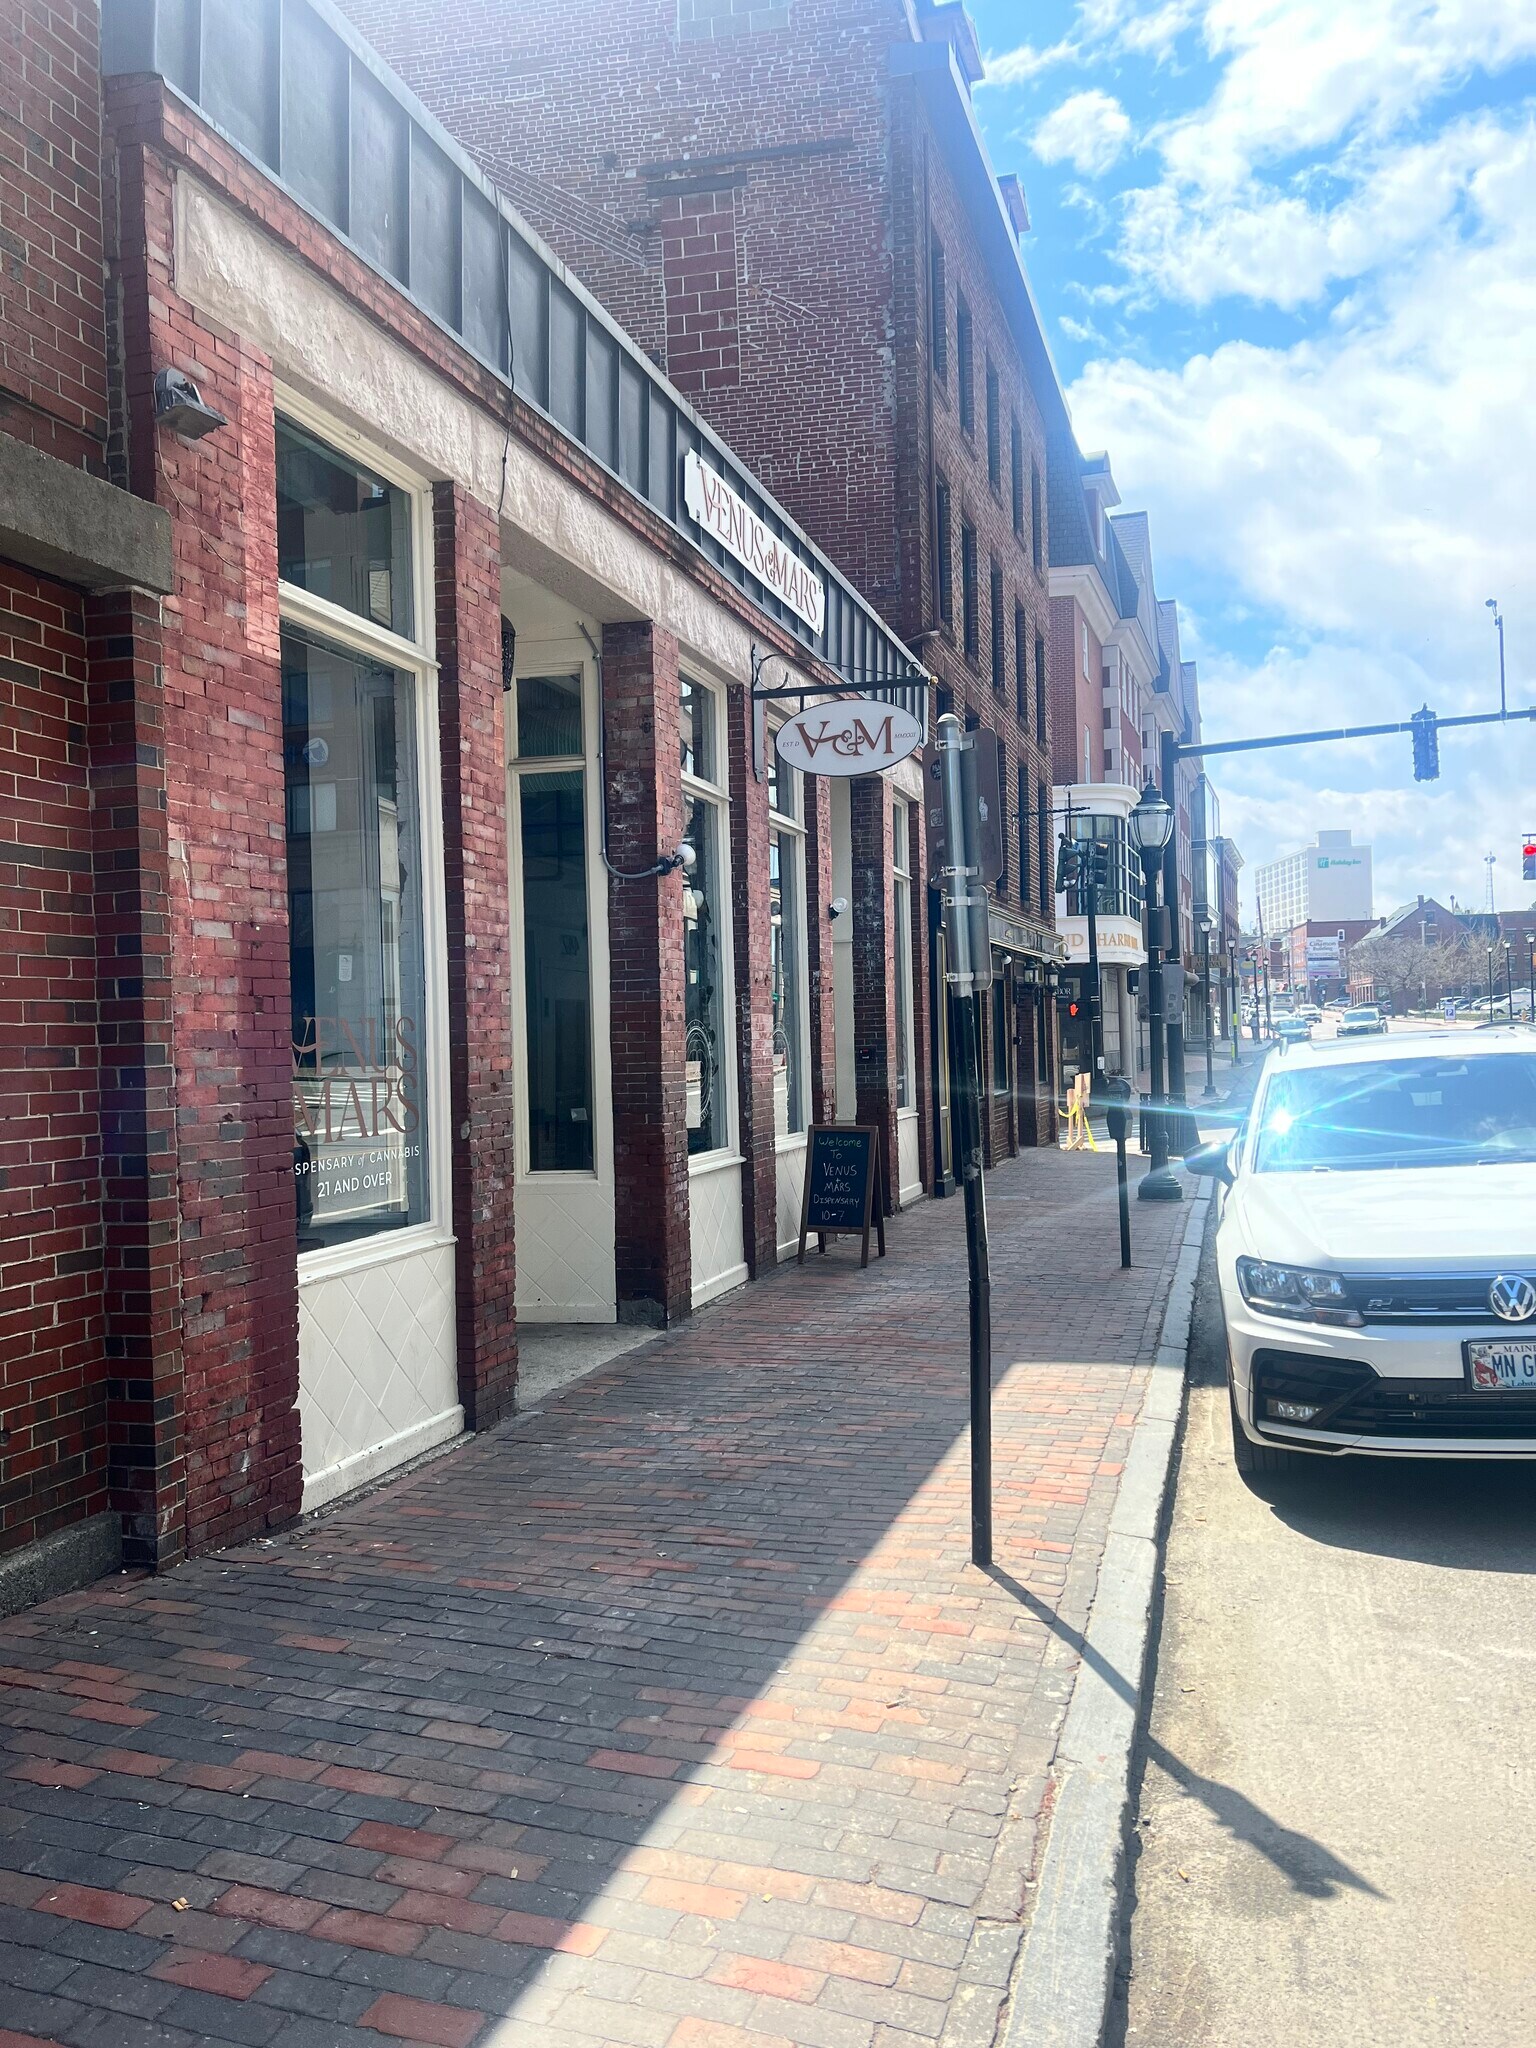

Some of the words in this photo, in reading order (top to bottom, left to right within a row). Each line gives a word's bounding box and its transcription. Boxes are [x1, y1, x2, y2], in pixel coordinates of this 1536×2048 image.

[292, 1074, 420, 1147] MARS
[818, 1136, 862, 1148] Welcome
[369, 1145, 420, 1164] CANNABIS
[830, 1149, 843, 1160] To
[823, 1162, 858, 1177] VENUS
[317, 1181, 330, 1198] 21
[334, 1176, 360, 1195] AND
[363, 1171, 393, 1191] OVER
[824, 1182, 851, 1193] MARS
